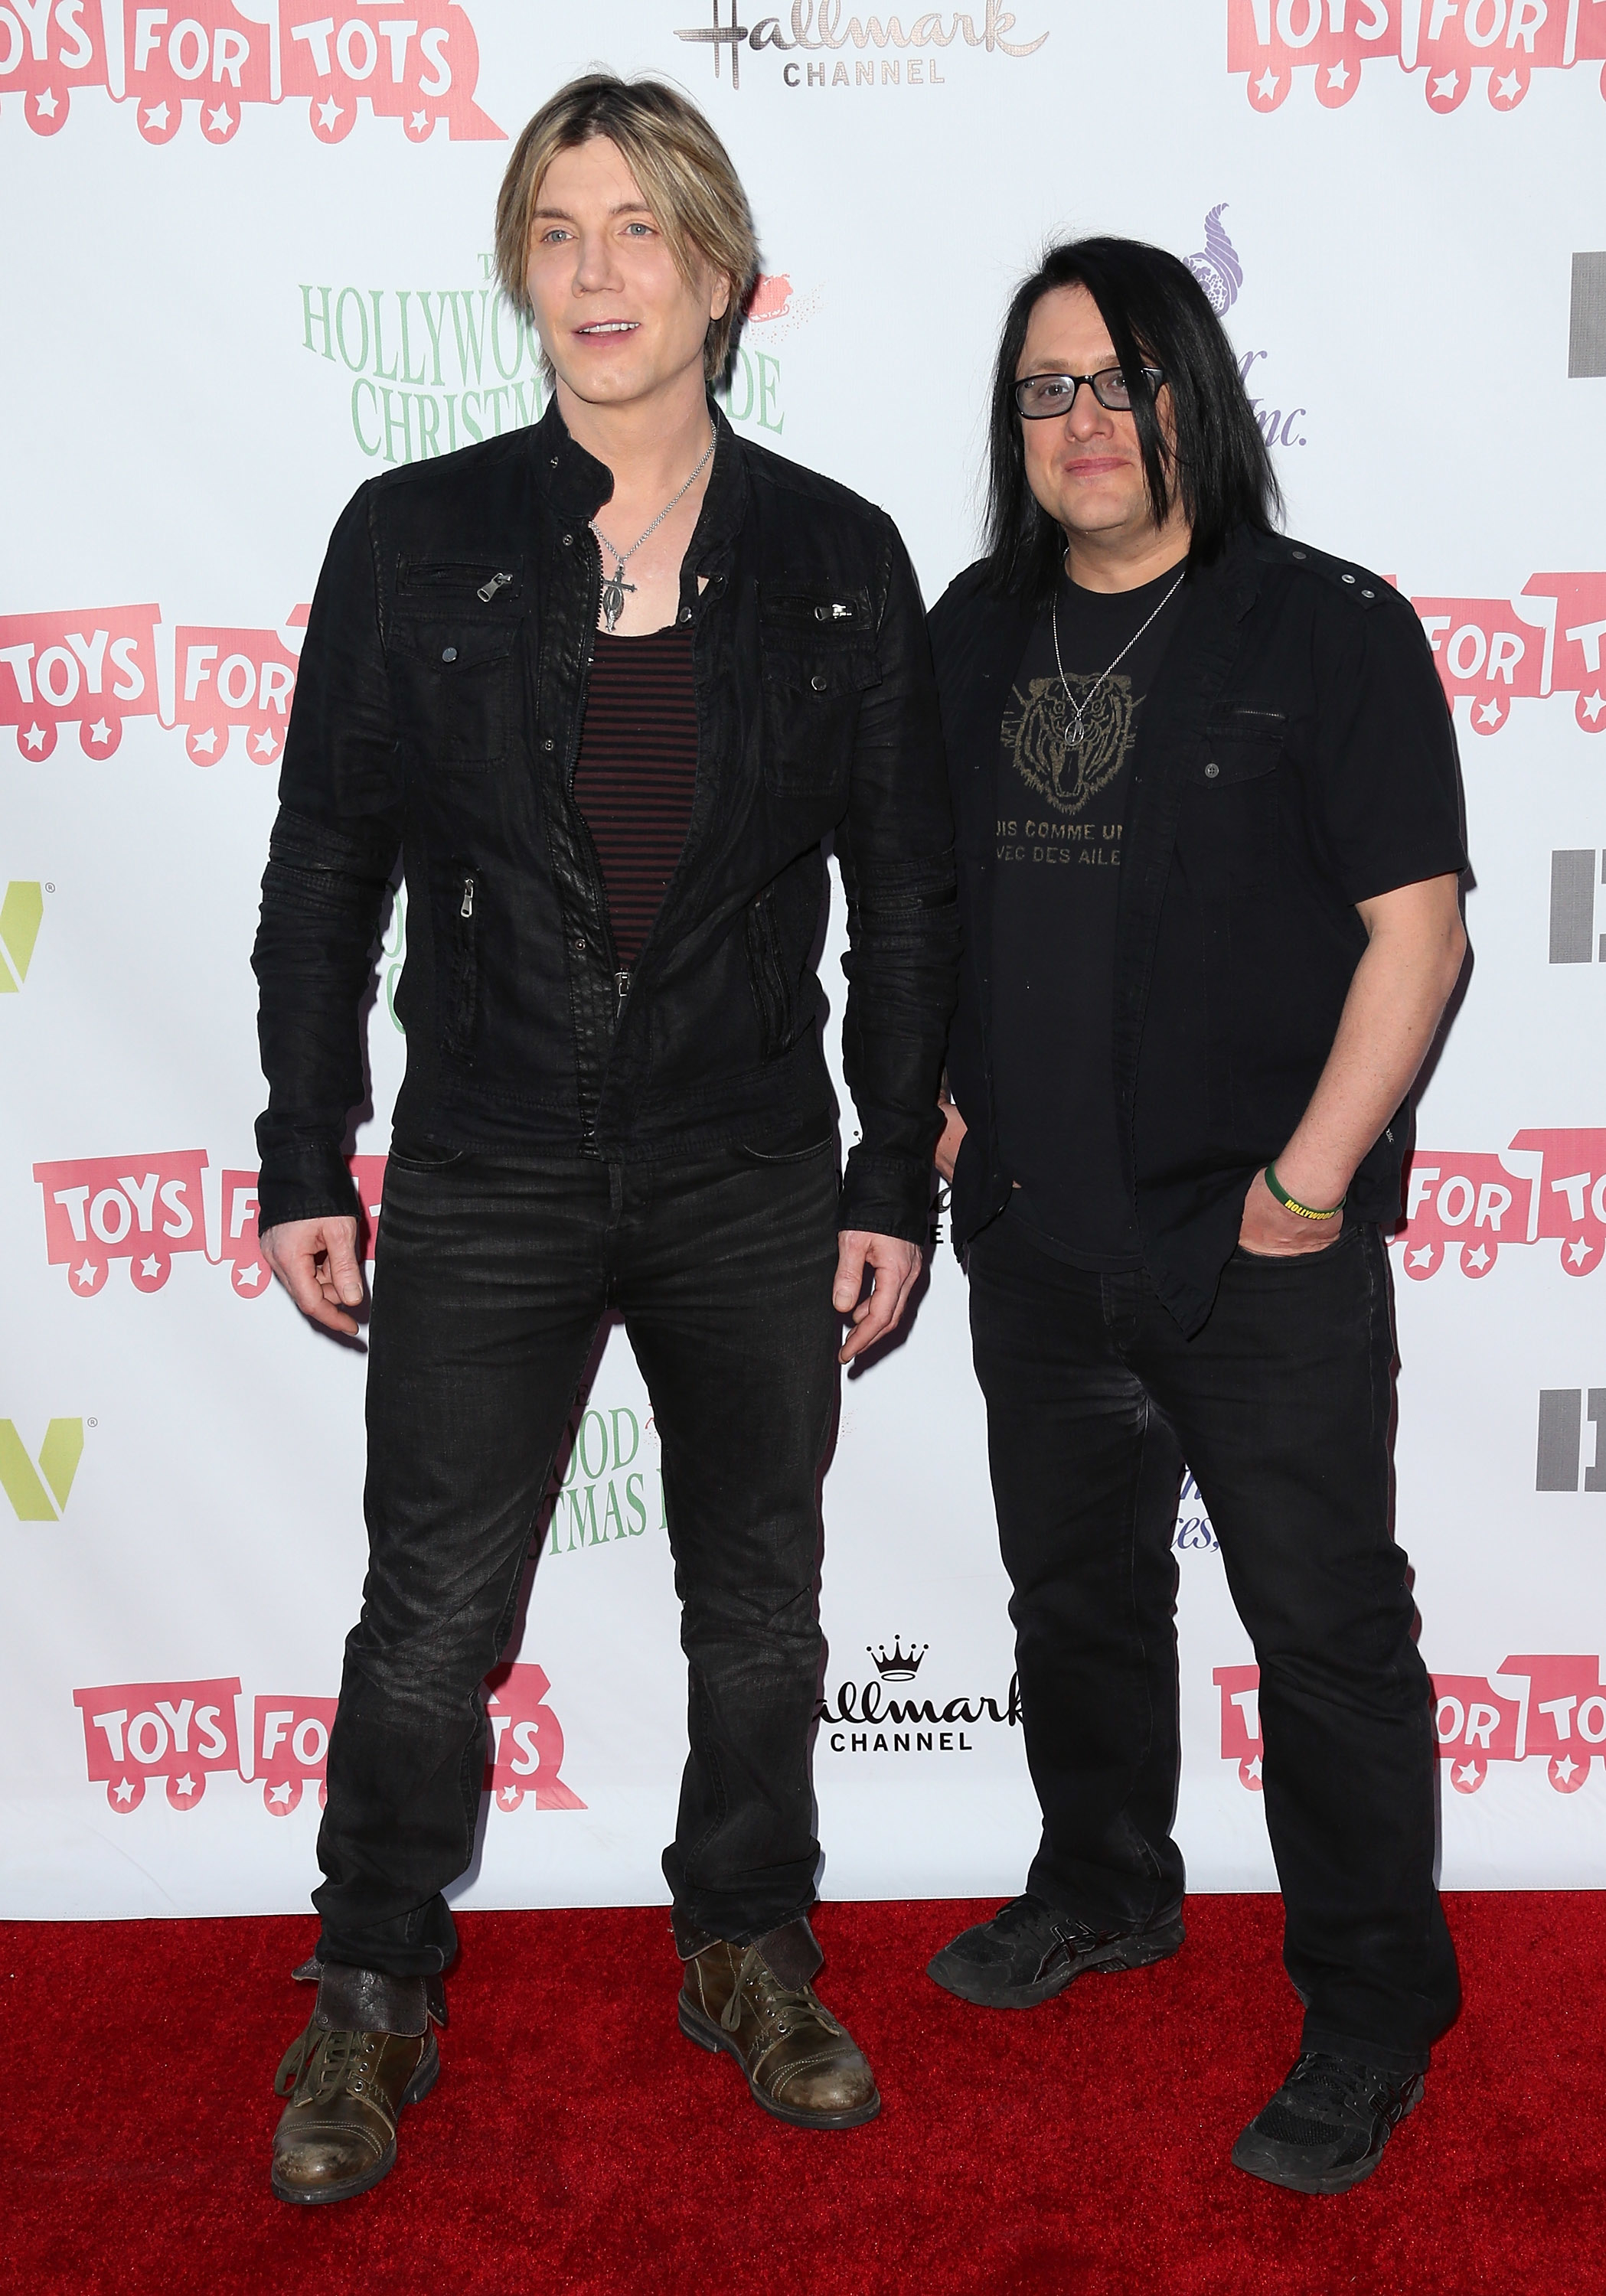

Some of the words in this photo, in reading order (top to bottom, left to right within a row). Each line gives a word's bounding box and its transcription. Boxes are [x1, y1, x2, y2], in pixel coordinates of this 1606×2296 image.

[135, 9, 250, 87] FOR
[291, 18, 452, 96] TOTS
[673, 0, 1049, 90] Hallmark
[783, 59, 945, 87] CHANNEL
[1247, 398, 1307, 448] nc.
[0, 630, 145, 707] TOYS
[184, 645, 295, 714] FOR
[1025, 820, 1095, 840] COMME
[1033, 846, 1070, 864] DES
[1079, 847, 1121, 866] AILE
[54, 1173, 193, 1244] TOYS
[1406, 1167, 1512, 1231] FOR
[93, 1699, 227, 1764] TOYS
[831, 1733, 973, 1753] CHANNEL
